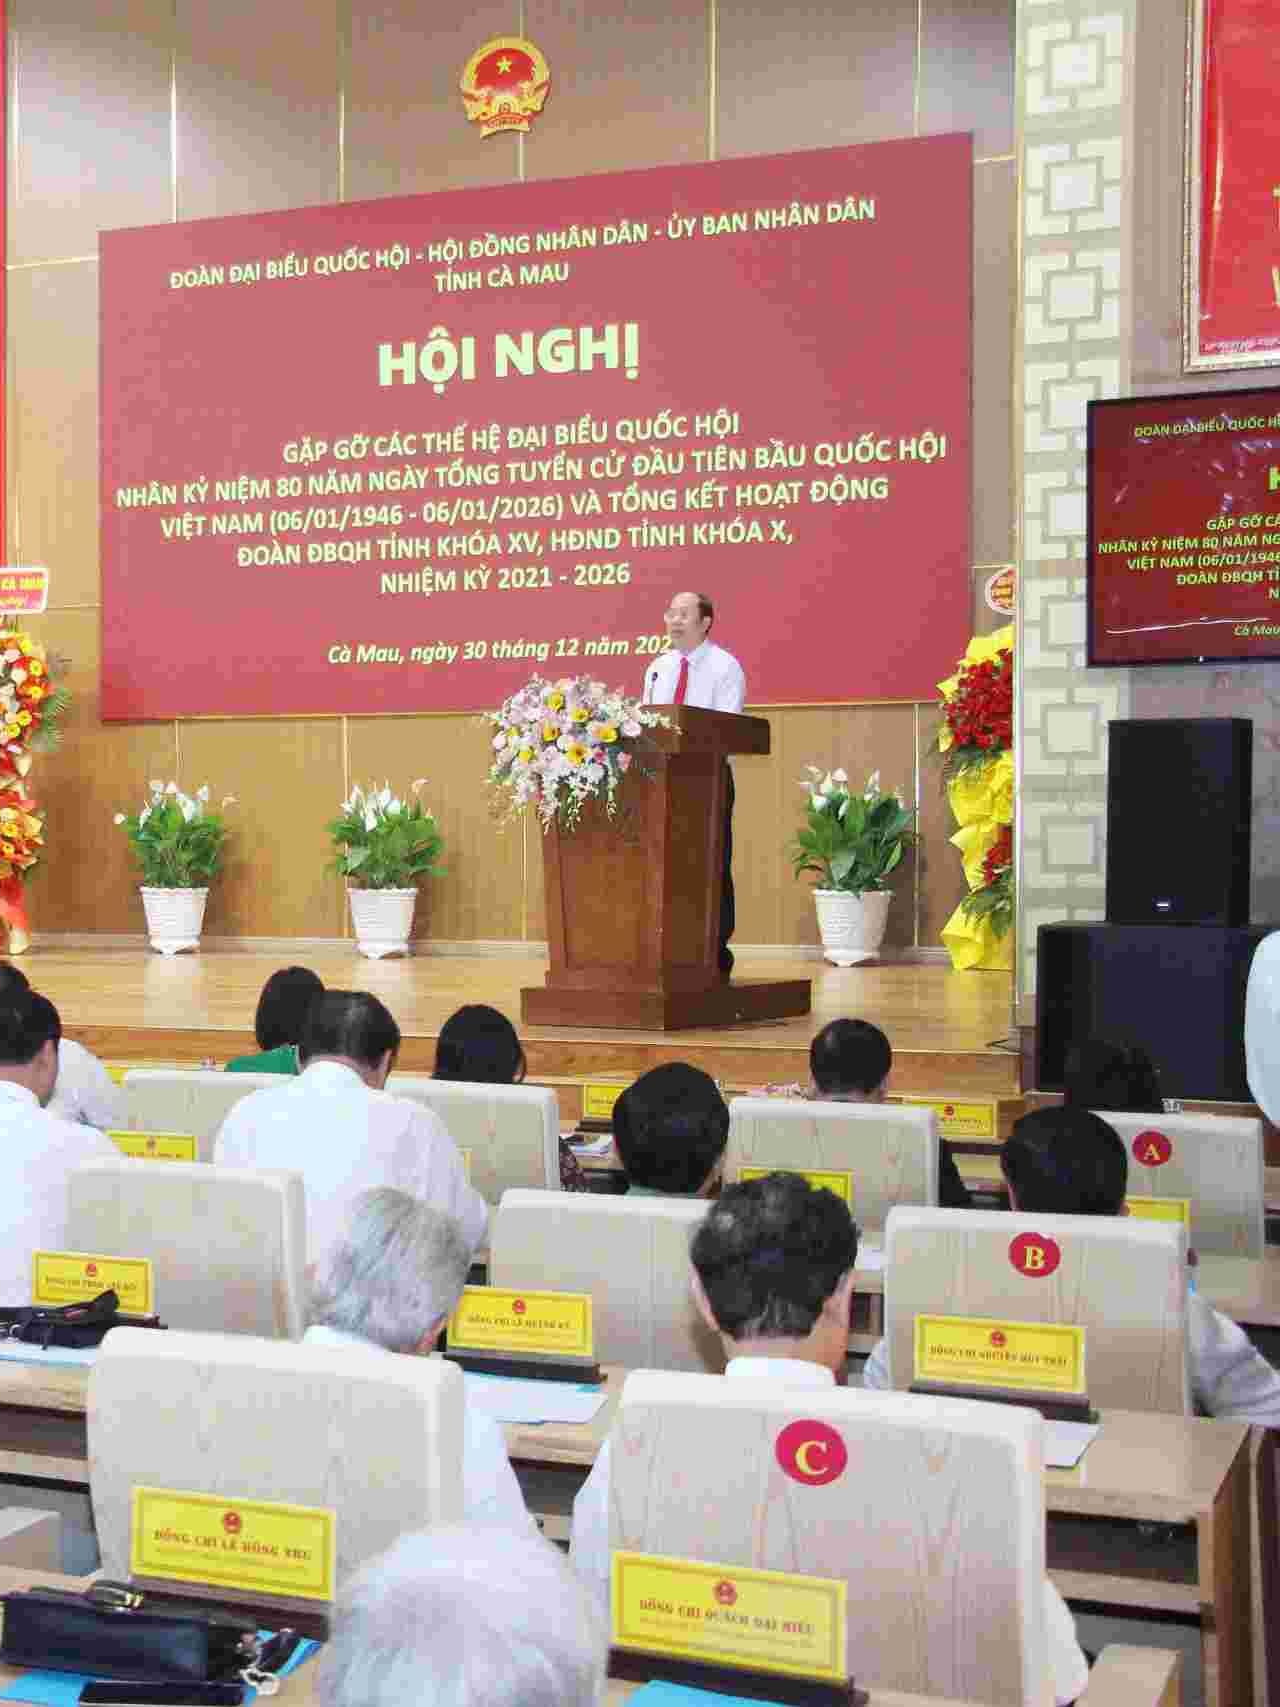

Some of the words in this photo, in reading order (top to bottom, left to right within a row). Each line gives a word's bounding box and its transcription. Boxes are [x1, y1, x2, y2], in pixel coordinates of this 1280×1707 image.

[170, 265, 224, 289] ĐOÀN
[229, 265, 260, 286] ĐẠI
[266, 253, 308, 280] BIỂU
[314, 246, 371, 277] QUỐC
[375, 244, 410, 271] HỘI
[428, 236, 463, 264] HỘI
[469, 232, 530, 258] ĐỒNG
[537, 226, 596, 252] NHÂN
[603, 218, 648, 245] DÂN
[667, 212, 697, 240] ỦY
[702, 212, 749, 236] BAN
[754, 202, 820, 230] NHÂN
[826, 196, 876, 224] DÂN
[435, 264, 481, 292] TỈNH
[487, 264, 514, 287] CÀ
[520, 262, 569, 286] MAU
[378, 325, 476, 394] HỘI
[495, 323, 639, 380] NGHỊ
[283, 437, 328, 466] GẶP
[334, 434, 370, 460] GỠ
[374, 432, 417, 457] CÁC
[422, 422, 467, 453] THẾ
[471, 423, 501, 454] HỆ
[507, 424, 547, 451] ĐẠI
[555, 413, 608, 445] BIỂU
[615, 409, 688, 443] QUỐC
[695, 408, 739, 439] HỘI
[117, 479, 177, 508] NHÂN
[215, 475, 271, 504] NIỆM
[276, 477, 302, 497] 80
[308, 468, 361, 495] NĂM
[368, 464, 429, 492] NGÀY
[434, 457, 500, 487] TỔNG
[506, 449, 582, 482] TUYỂN
[590, 446, 626, 478] CỬ
[632, 446, 683, 476] ĐẦU
[692, 443, 746, 472] TIÊN
[755, 437, 806, 468] BẦU
[814, 432, 892, 467] QUỐC
[899, 430, 946, 463] HỘI
[161, 512, 206, 540] VIỆT
[212, 513, 263, 535] NAM
[270, 504, 403, 533] (06/01/1946
[423, 494, 563, 526] 06/01/2026)
[570, 488, 602, 515] VÀ
[608, 481, 676, 512] TỔNG
[685, 478, 729, 510] KẾT
[735, 480, 804, 509] HOẠT
[810, 473, 889, 506] ĐỘNG
[237, 540, 301, 567] ĐOÀN
[307, 541, 371, 564] ĐBQH
[377, 532, 430, 560] TỈNH
[438, 529, 502, 557] KHÓA
[507, 532, 544, 556] XV,
[551, 529, 620, 551] HĐND
[627, 519, 684, 548] TỈNH
[693, 516, 764, 544] KHÓA
[770, 519, 793, 544] X,
[1162, 536, 1199, 552] NIỆM
[1202, 538, 1219, 549] 80
[380, 568, 457, 597] NHIỆM
[463, 563, 491, 591] KỲ
[497, 567, 553, 590] 2021
[574, 563, 631, 586] 2026
[1127, 556, 1157, 571] VIỆT
[1160, 556, 1194, 569] NAM
[328, 643, 352, 663] Cà
[356, 644, 404, 665] Mau,
[410, 643, 458, 665] ngày
[463, 640, 487, 660] 30
[492, 638, 549, 662] tháng
[554, 638, 578, 657] 12
[584, 636, 630, 657] năm
[634, 636, 671, 655] 202
[1144, 1143, 1161, 1161] A
[1024, 1245, 1046, 1269] B
[795, 1440, 828, 1475] C
